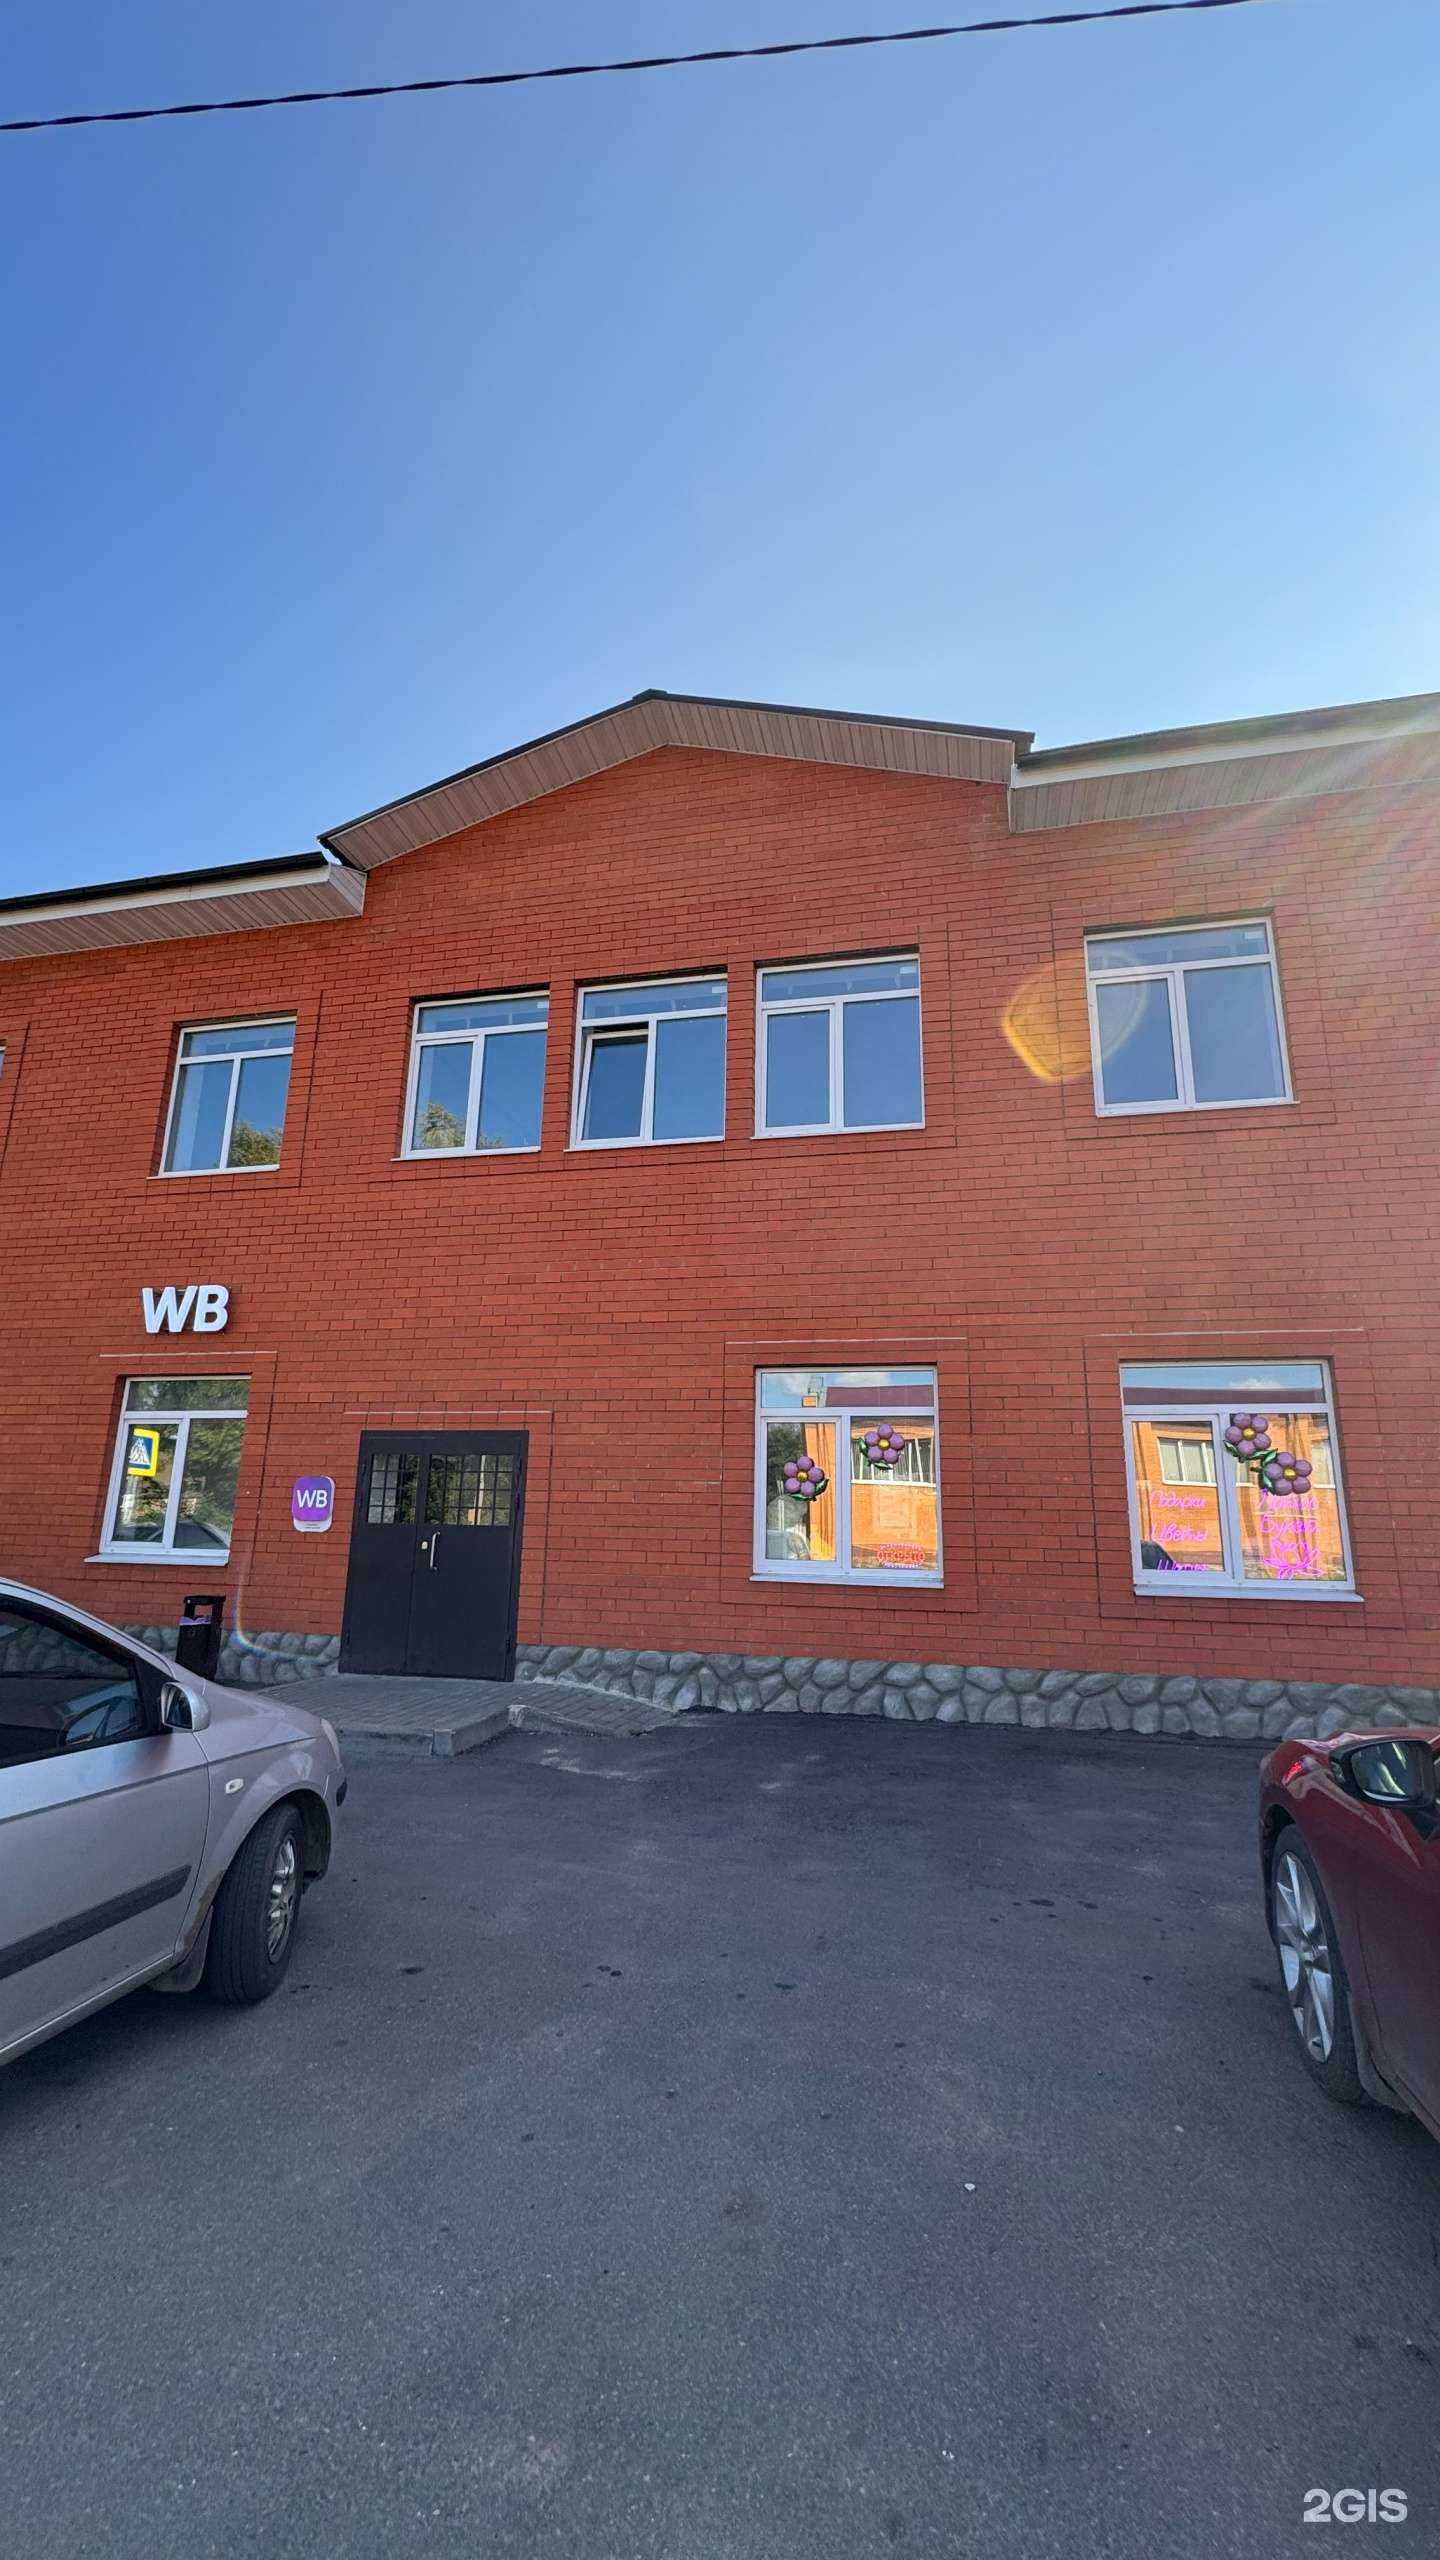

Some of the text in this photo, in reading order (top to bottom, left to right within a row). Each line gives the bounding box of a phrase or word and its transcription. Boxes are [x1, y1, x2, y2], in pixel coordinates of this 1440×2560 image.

[142, 1285, 229, 1333] WB
[296, 1489, 328, 1508] WB
[1151, 1520, 1209, 1543] Цветы
